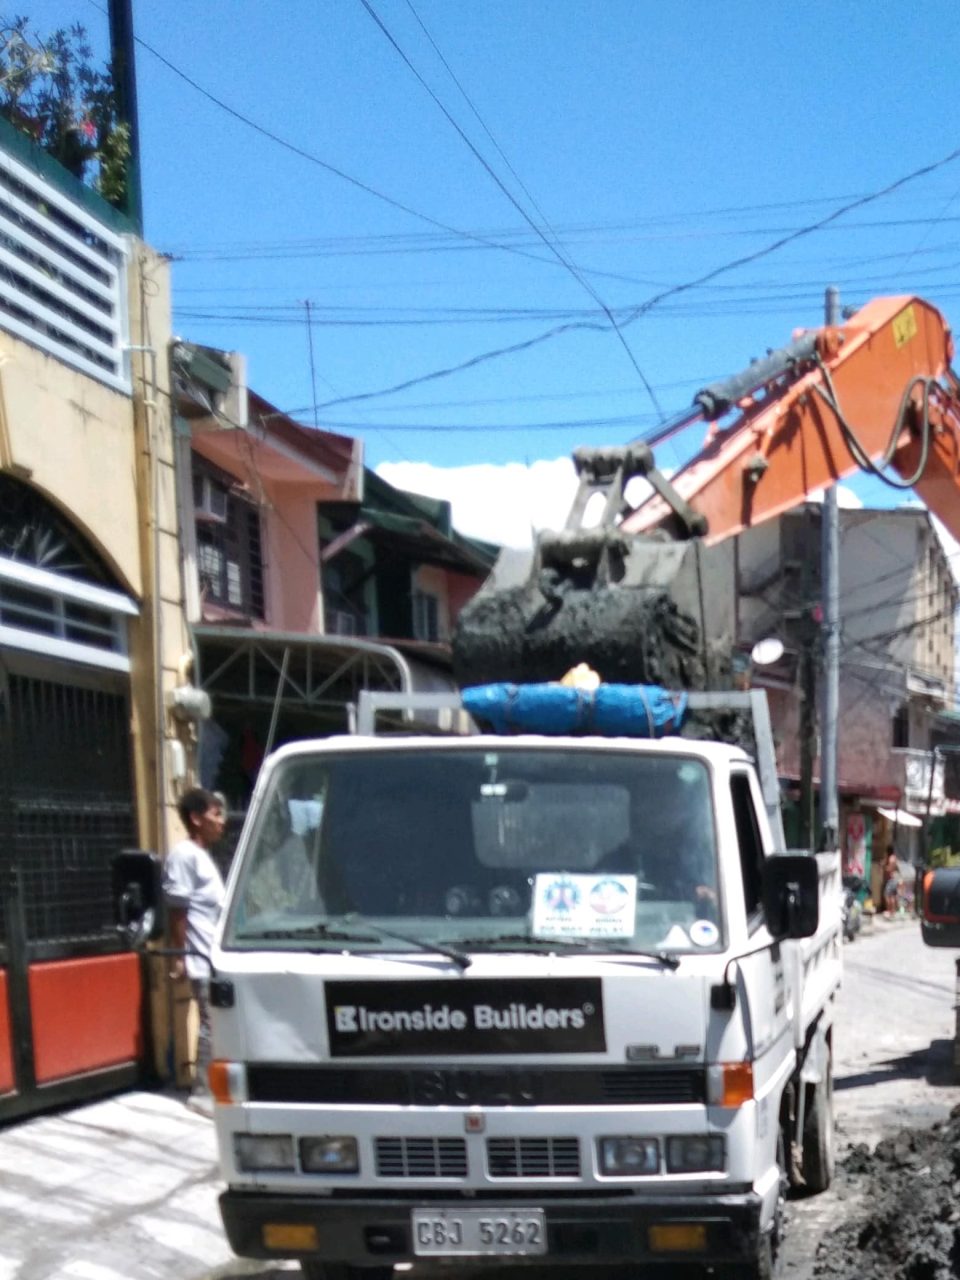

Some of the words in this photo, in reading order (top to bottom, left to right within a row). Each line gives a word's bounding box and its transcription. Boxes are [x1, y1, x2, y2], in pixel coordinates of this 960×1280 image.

[359, 1003, 467, 1032] Ironside
[417, 1218, 462, 1245] CBJ
[479, 1218, 541, 1245] 5262
